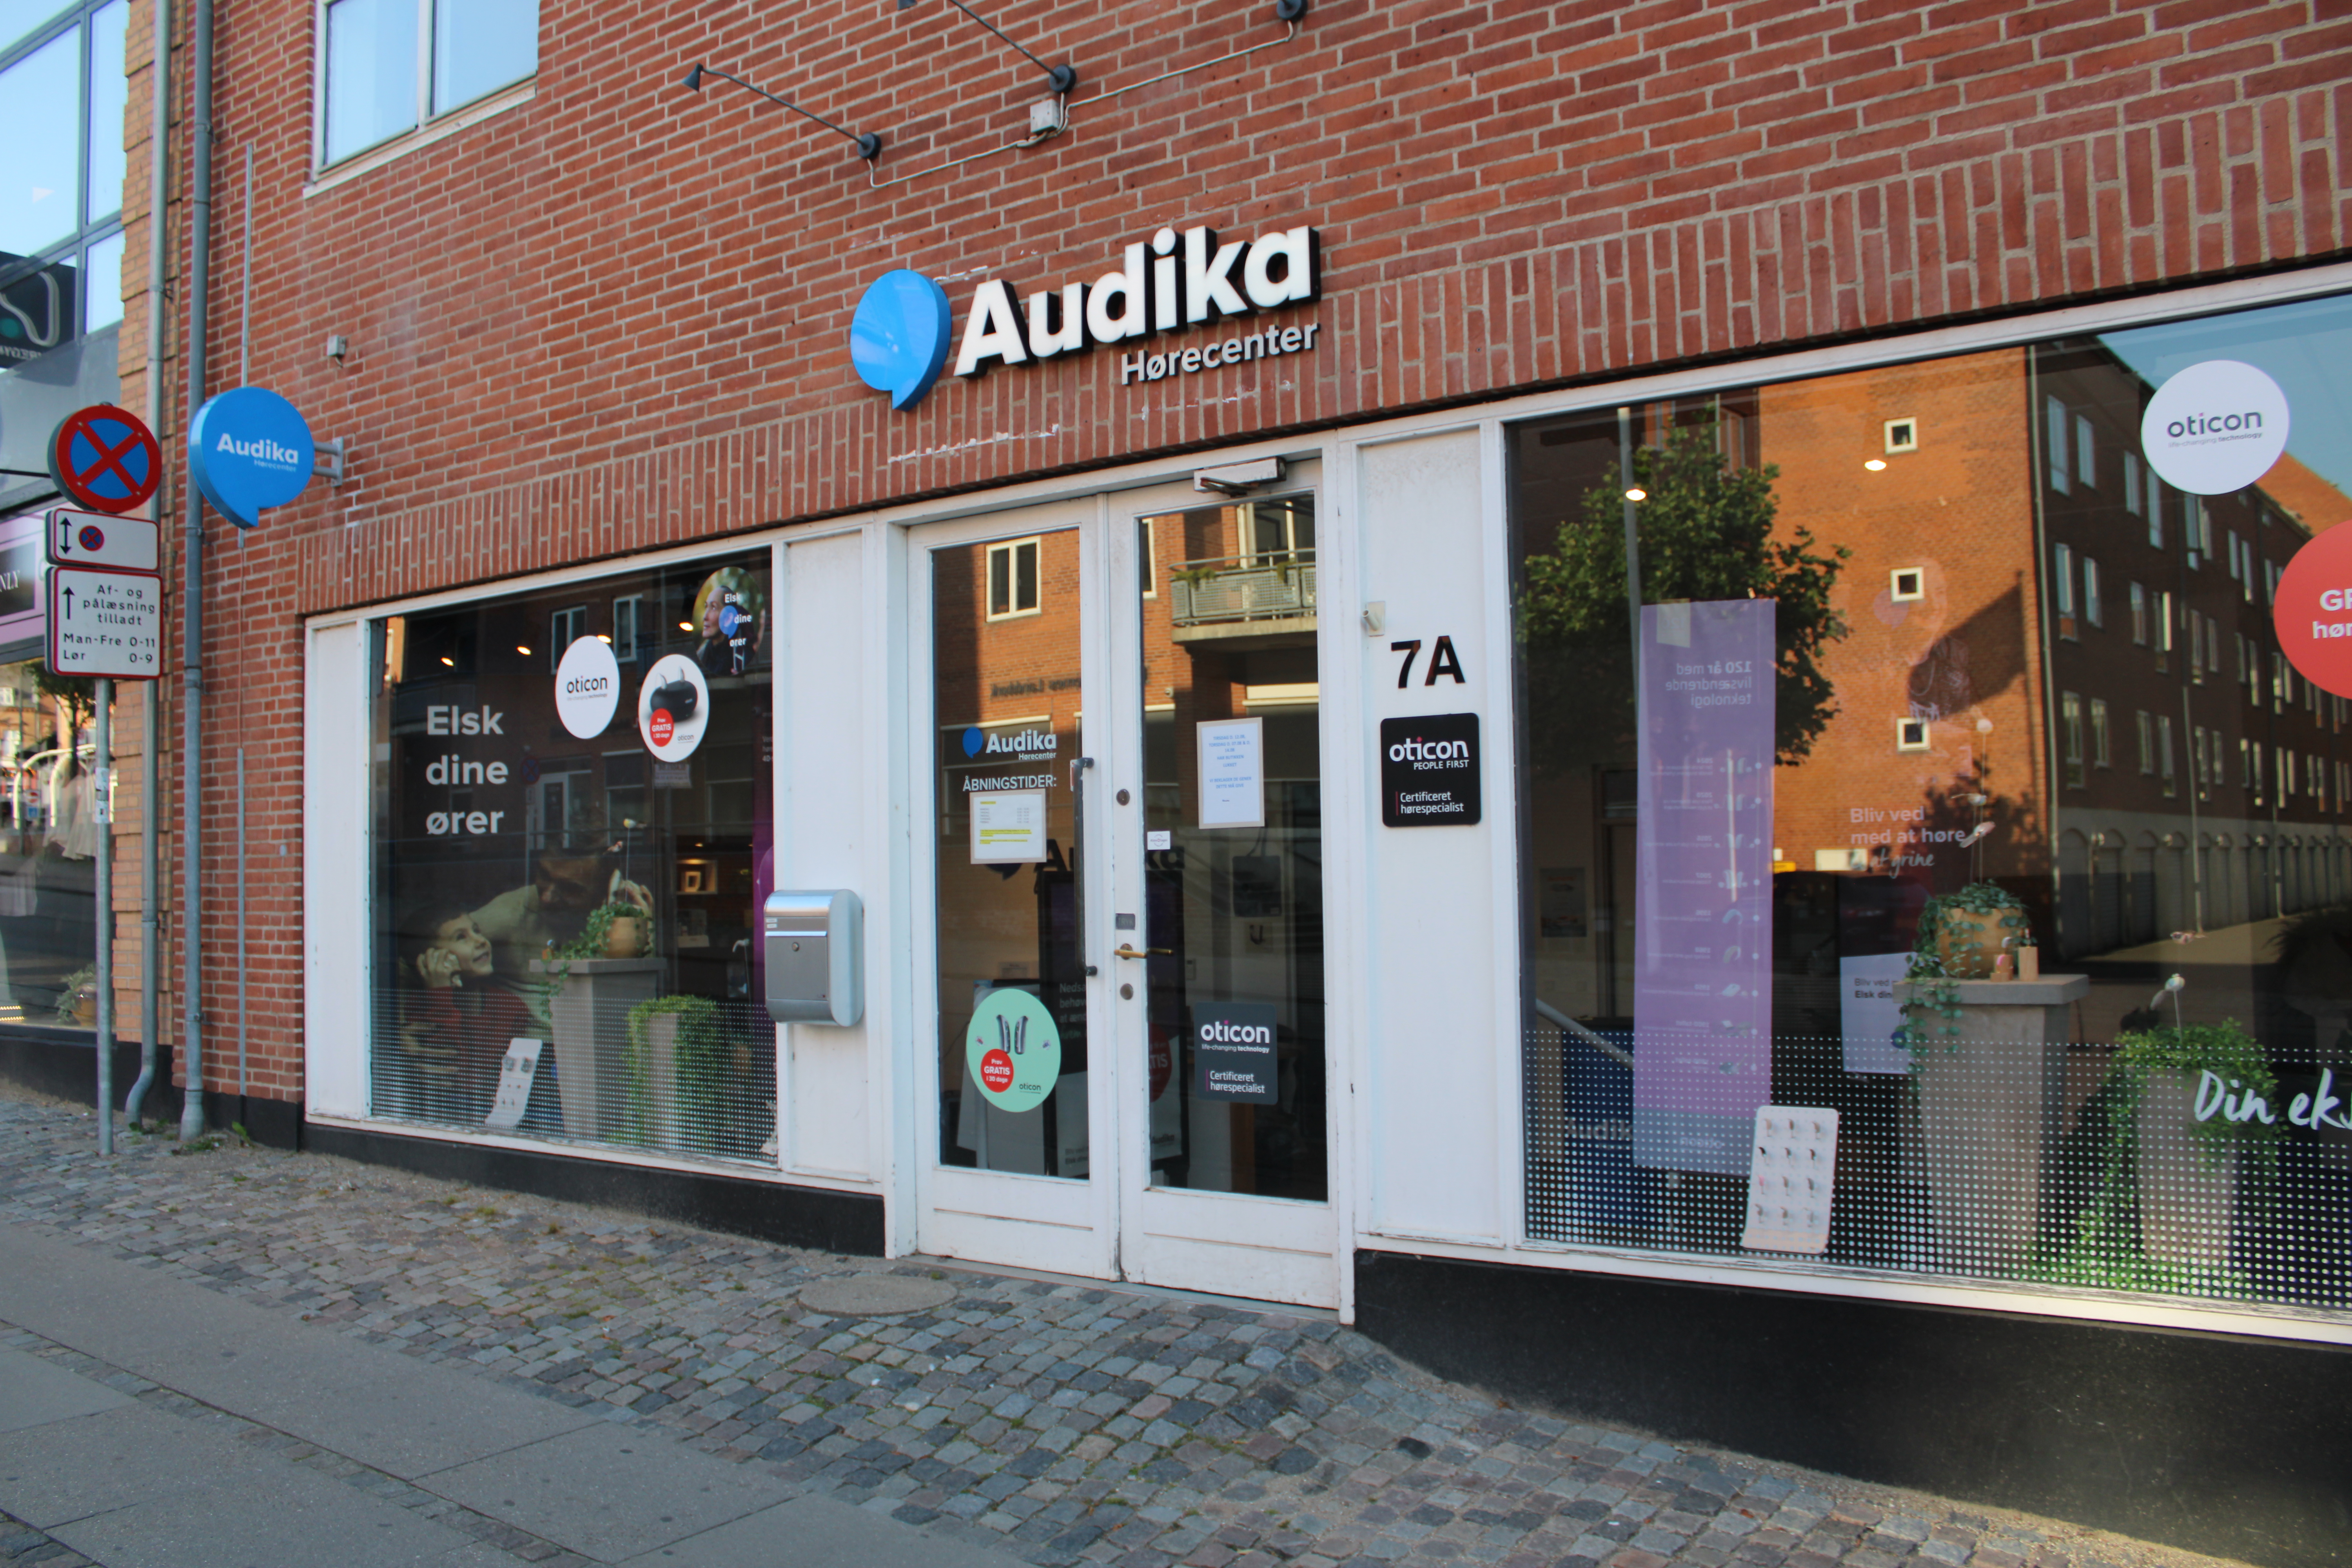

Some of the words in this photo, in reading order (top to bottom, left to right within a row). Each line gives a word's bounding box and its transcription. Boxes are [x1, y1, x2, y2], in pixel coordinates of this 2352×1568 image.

[954, 225, 1318, 377] Audika
[1122, 322, 1319, 386] Hørecenter
[2166, 412, 2262, 439] oticon
[2168, 438, 2217, 448] life-changing
[2218, 432, 2263, 442] technology
[217, 433, 299, 464] Audika
[254, 459, 297, 473] Hørecenter
[97, 585, 118, 594] Af-
[127, 589, 143, 600] og
[724, 593, 740, 603] Elsk
[83, 598, 156, 615] pålæsning
[98, 613, 142, 626] tilladt
[734, 613, 753, 624] dine
[64, 633, 122, 647] Man-Fre
[130, 637, 156, 648] 0-11
[729, 638, 747, 647] ører
[64, 650, 86, 660] Lør
[130, 653, 153, 664] 0-9
[1391, 635, 1466, 689] 7A
[567, 675, 608, 693] oticon
[428, 705, 503, 735] Elsk
[652, 724, 672, 732] GRATIS
[985, 729, 1056, 754] Audika
[1389, 736, 1469, 762] oticon
[1019, 751, 1056, 760] Hørecenter
[426, 755, 508, 785] dine
[1414, 761, 1443, 771] PEOPLE
[1446, 760, 1469, 769] FIRST
[963, 775, 1057, 791] ÅBNINGSTIDER:
[1400, 791, 1451, 803] Certificeret
[1401, 802, 1464, 815] hørespecialist
[1850, 808, 1885, 823] Bliv
[1889, 806, 1925, 821] ved
[426, 810, 504, 835] ører
[1851, 828, 1891, 844] med
[1896, 829, 1916, 844] at
[1922, 828, 1965, 843] høre
[1889, 851, 1935, 879] grine
[1873, 978, 1890, 987] ved
[1060, 998, 1086, 1009] behøv
[1201, 1020, 1270, 1044] oticon
[1201, 1044, 1237, 1052] life-changing
[1237, 1045, 1270, 1054] technology
[984, 1066, 1010, 1075] GRATIS
[1210, 1070, 1254, 1082] Certificeret
[1019, 1083, 1041, 1091] oticon
[1210, 1081, 1265, 1094] hørespecialist
[2194, 1069, 2276, 1124] Din
[2288, 1067, 2352, 1130] ek
